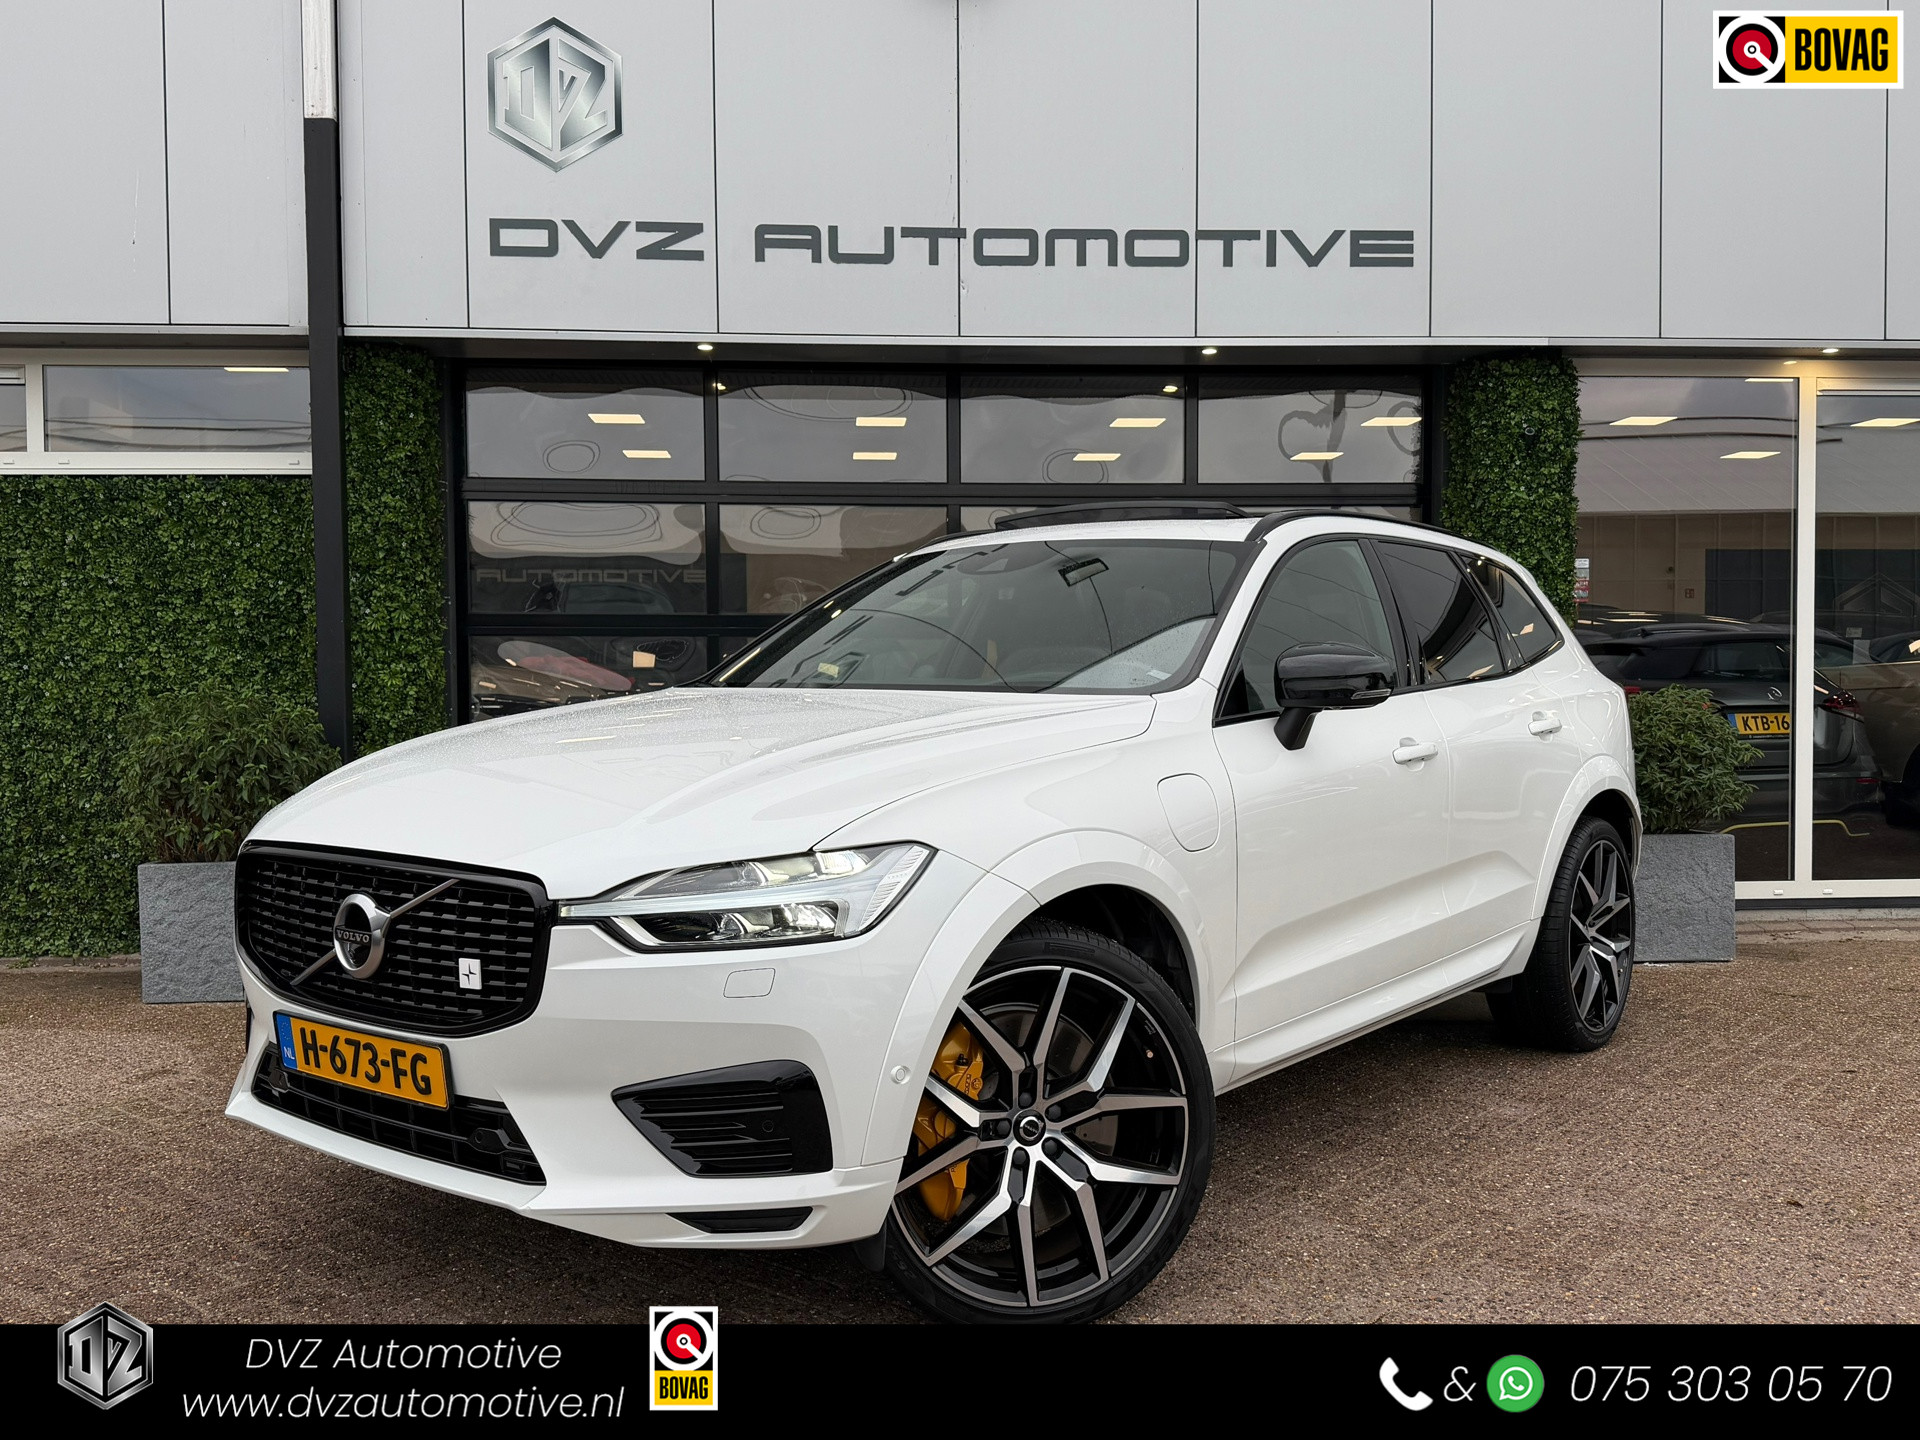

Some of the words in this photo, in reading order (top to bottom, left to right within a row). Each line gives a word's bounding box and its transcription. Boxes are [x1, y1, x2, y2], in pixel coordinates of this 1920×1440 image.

[489, 217, 705, 261] DVZ
[754, 224, 1414, 268] AUTOMOTIVE
[476, 568, 706, 583] AUTOMOTIVE
[1741, 715, 1790, 732] KTB-16
[336, 929, 370, 943] VOLVO
[283, 1046, 295, 1060] NL
[300, 1027, 432, 1095] H-673-FG
